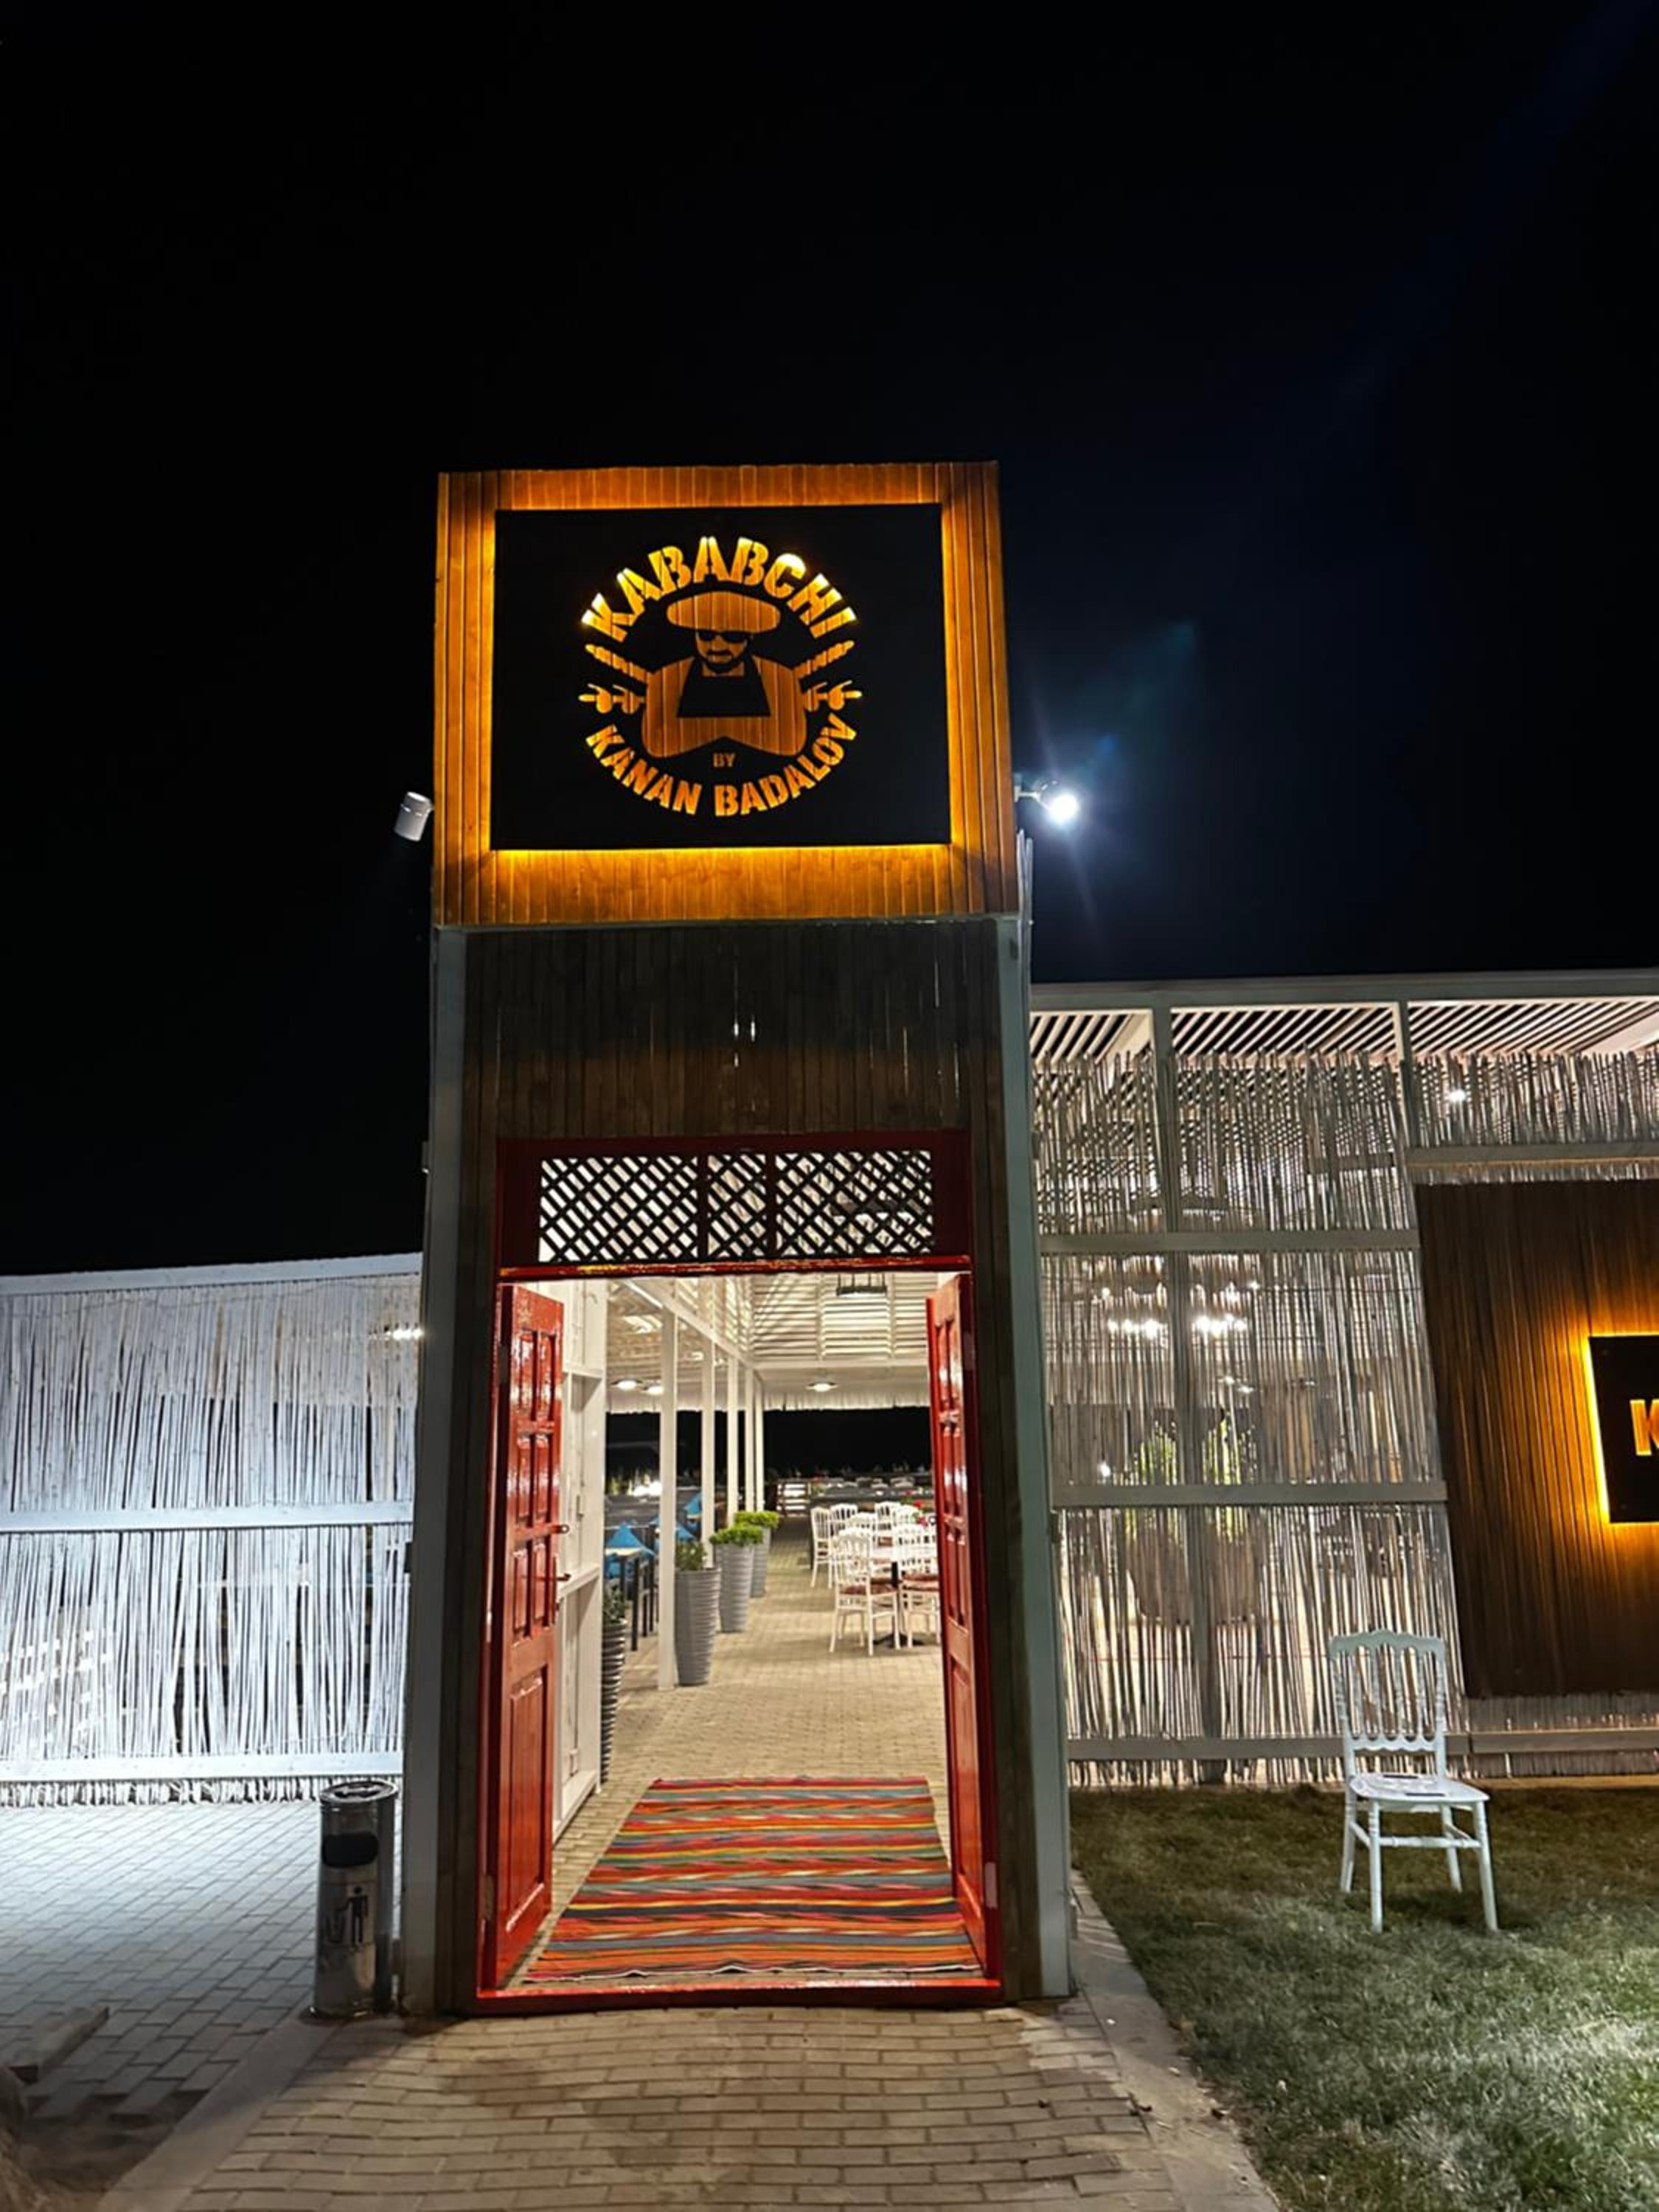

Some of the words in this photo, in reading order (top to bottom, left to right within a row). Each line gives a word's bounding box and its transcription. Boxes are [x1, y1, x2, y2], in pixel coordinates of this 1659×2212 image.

[581, 537, 856, 641] KABABCHI
[585, 726, 701, 815] KANAN
[714, 714, 857, 817] BADALOV
[713, 752, 736, 768] BY
